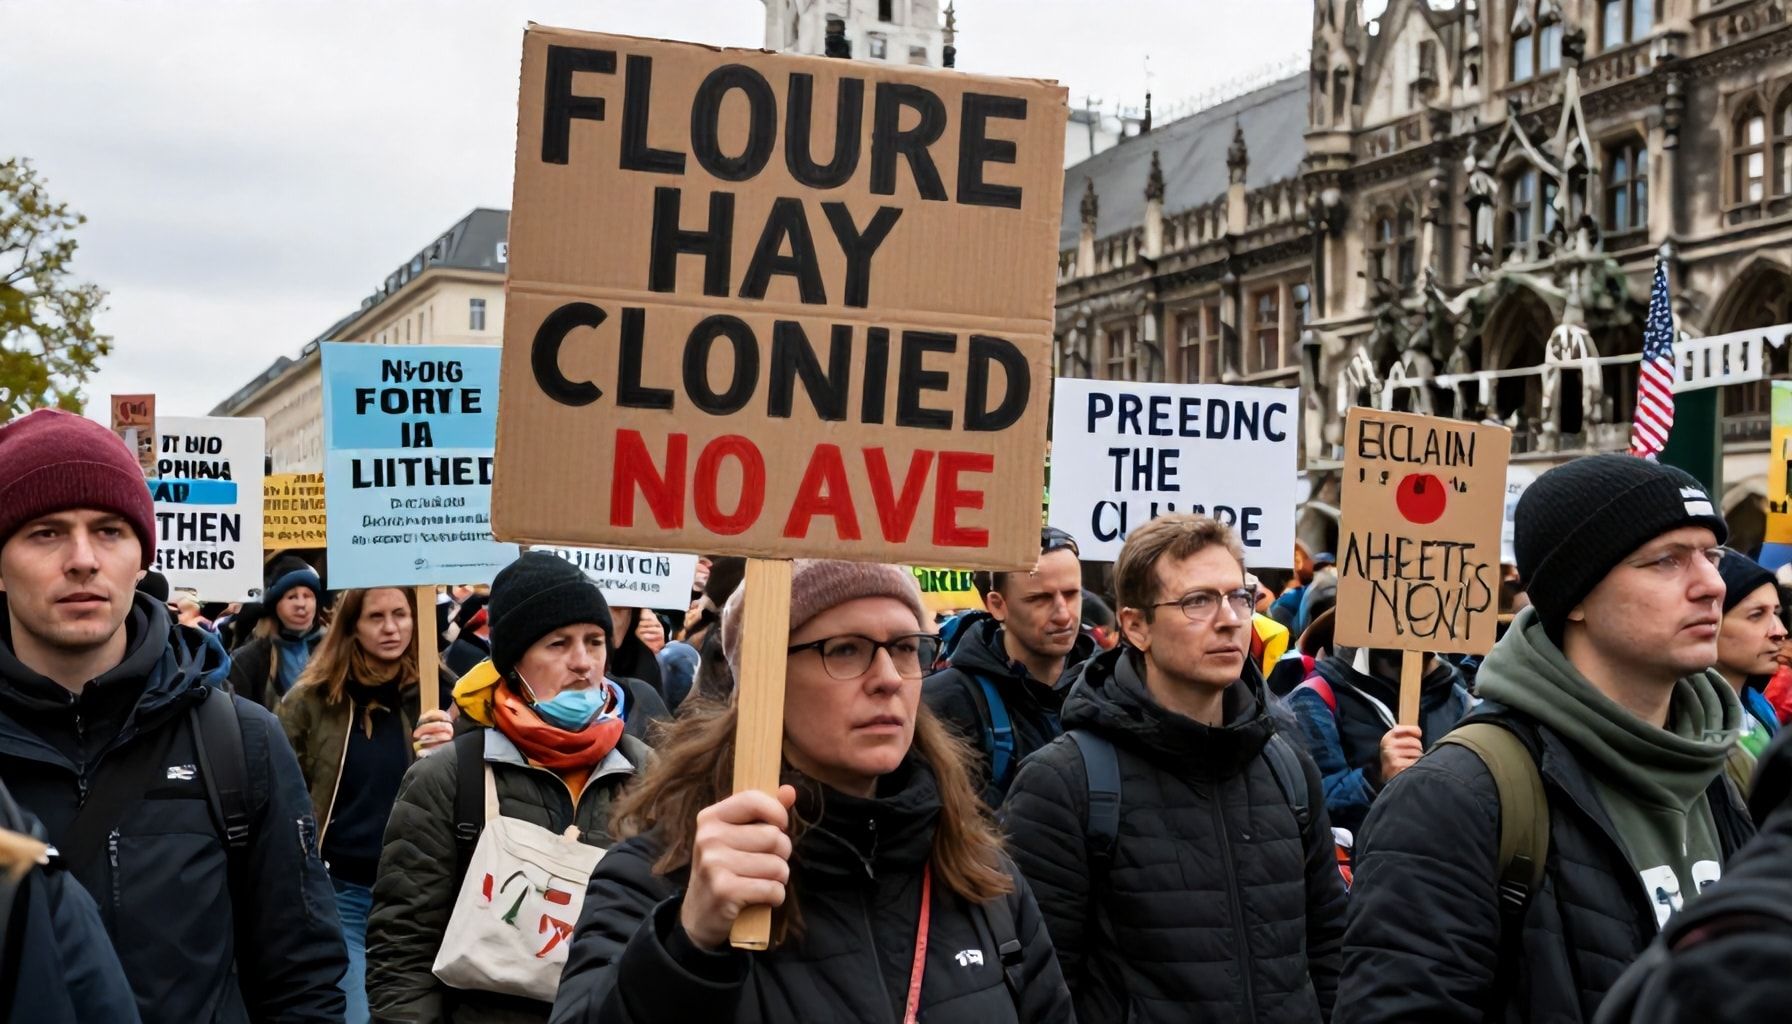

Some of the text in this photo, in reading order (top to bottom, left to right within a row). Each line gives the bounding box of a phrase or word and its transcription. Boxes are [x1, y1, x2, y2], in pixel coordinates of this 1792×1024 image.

[541, 44, 1028, 209] FLOURE
[648, 187, 903, 308] HAY
[531, 302, 1032, 431] CLONIED
[1087, 392, 1287, 442] PREEDNC
[610, 429, 995, 548] NO AVE
[1108, 447, 1180, 492] THE
